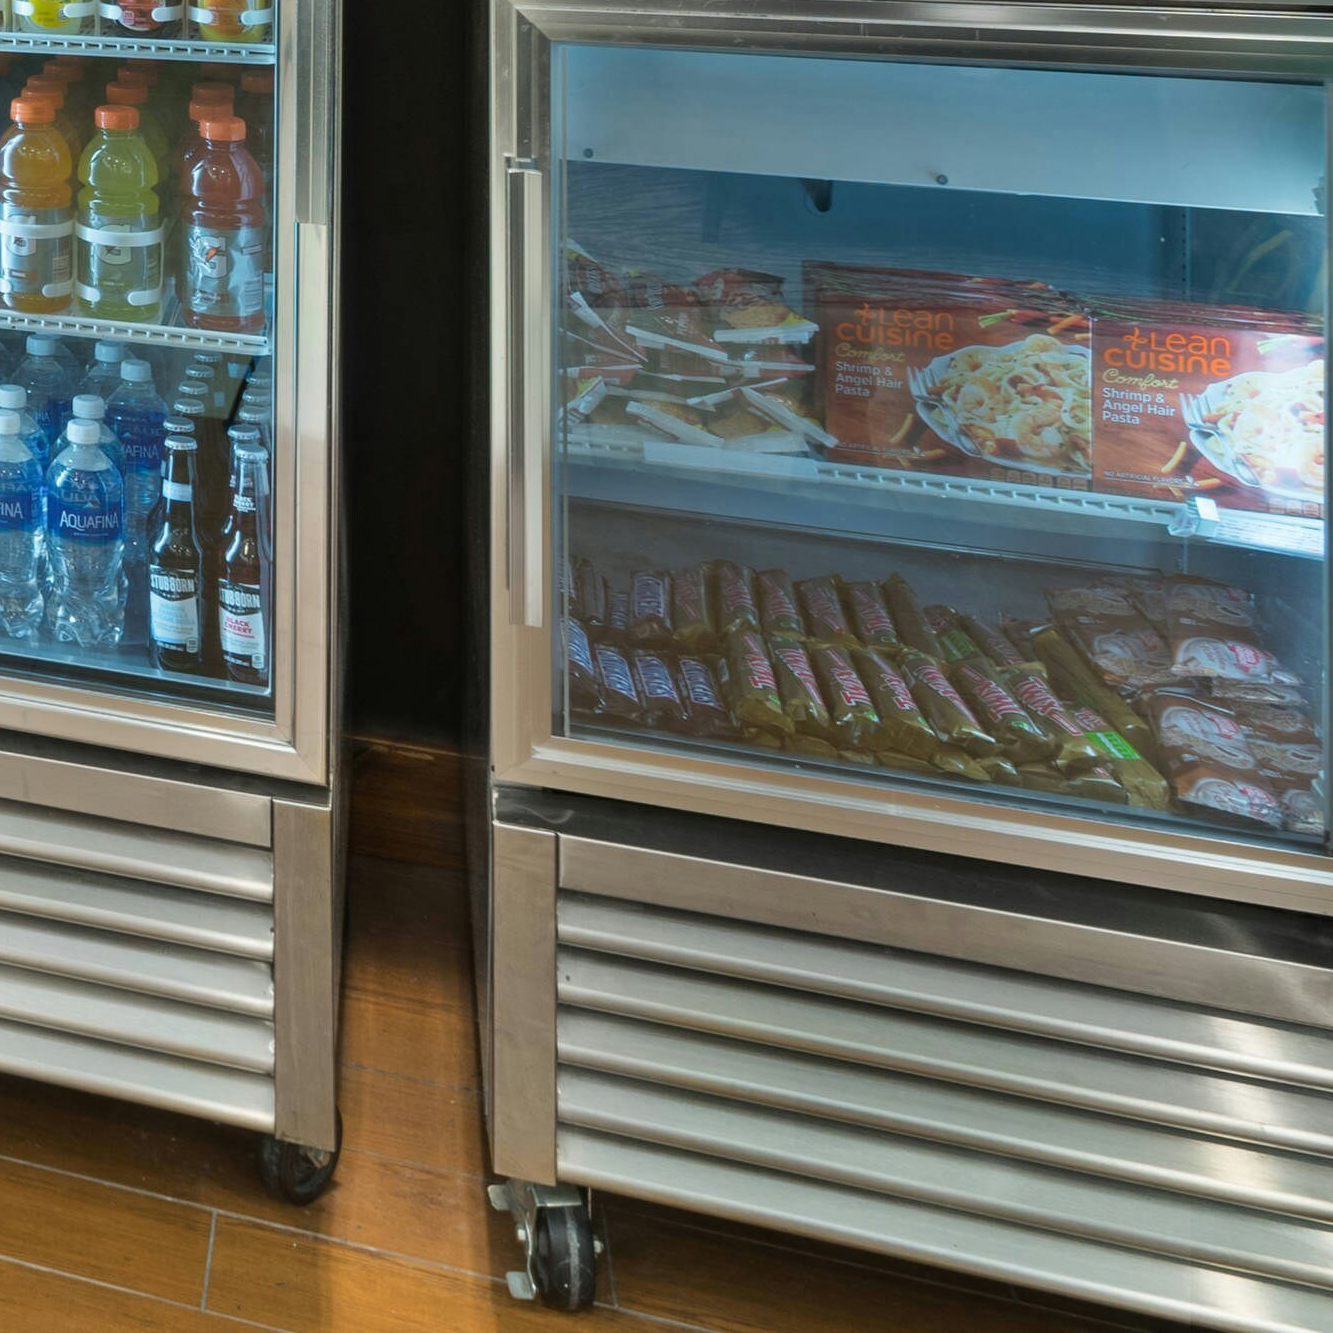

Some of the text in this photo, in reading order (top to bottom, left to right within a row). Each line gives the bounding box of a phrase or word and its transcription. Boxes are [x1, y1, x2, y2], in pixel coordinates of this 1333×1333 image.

[878, 305, 954, 331] Lean
[835, 343, 906, 364] Comfort
[1149, 332, 1231, 357] Lean
[835, 360, 894, 378] Shrimp &
[835, 372, 902, 390] Angel Hair
[1102, 368, 1180, 391] Comfort
[835, 383, 871, 398] Pasta
[1102, 387, 1166, 404] Shrimp &
[1102, 399, 1176, 417] Angel Hair
[1102, 410, 1141, 426] Pasta
[59, 511, 119, 531] AQUAFINA
